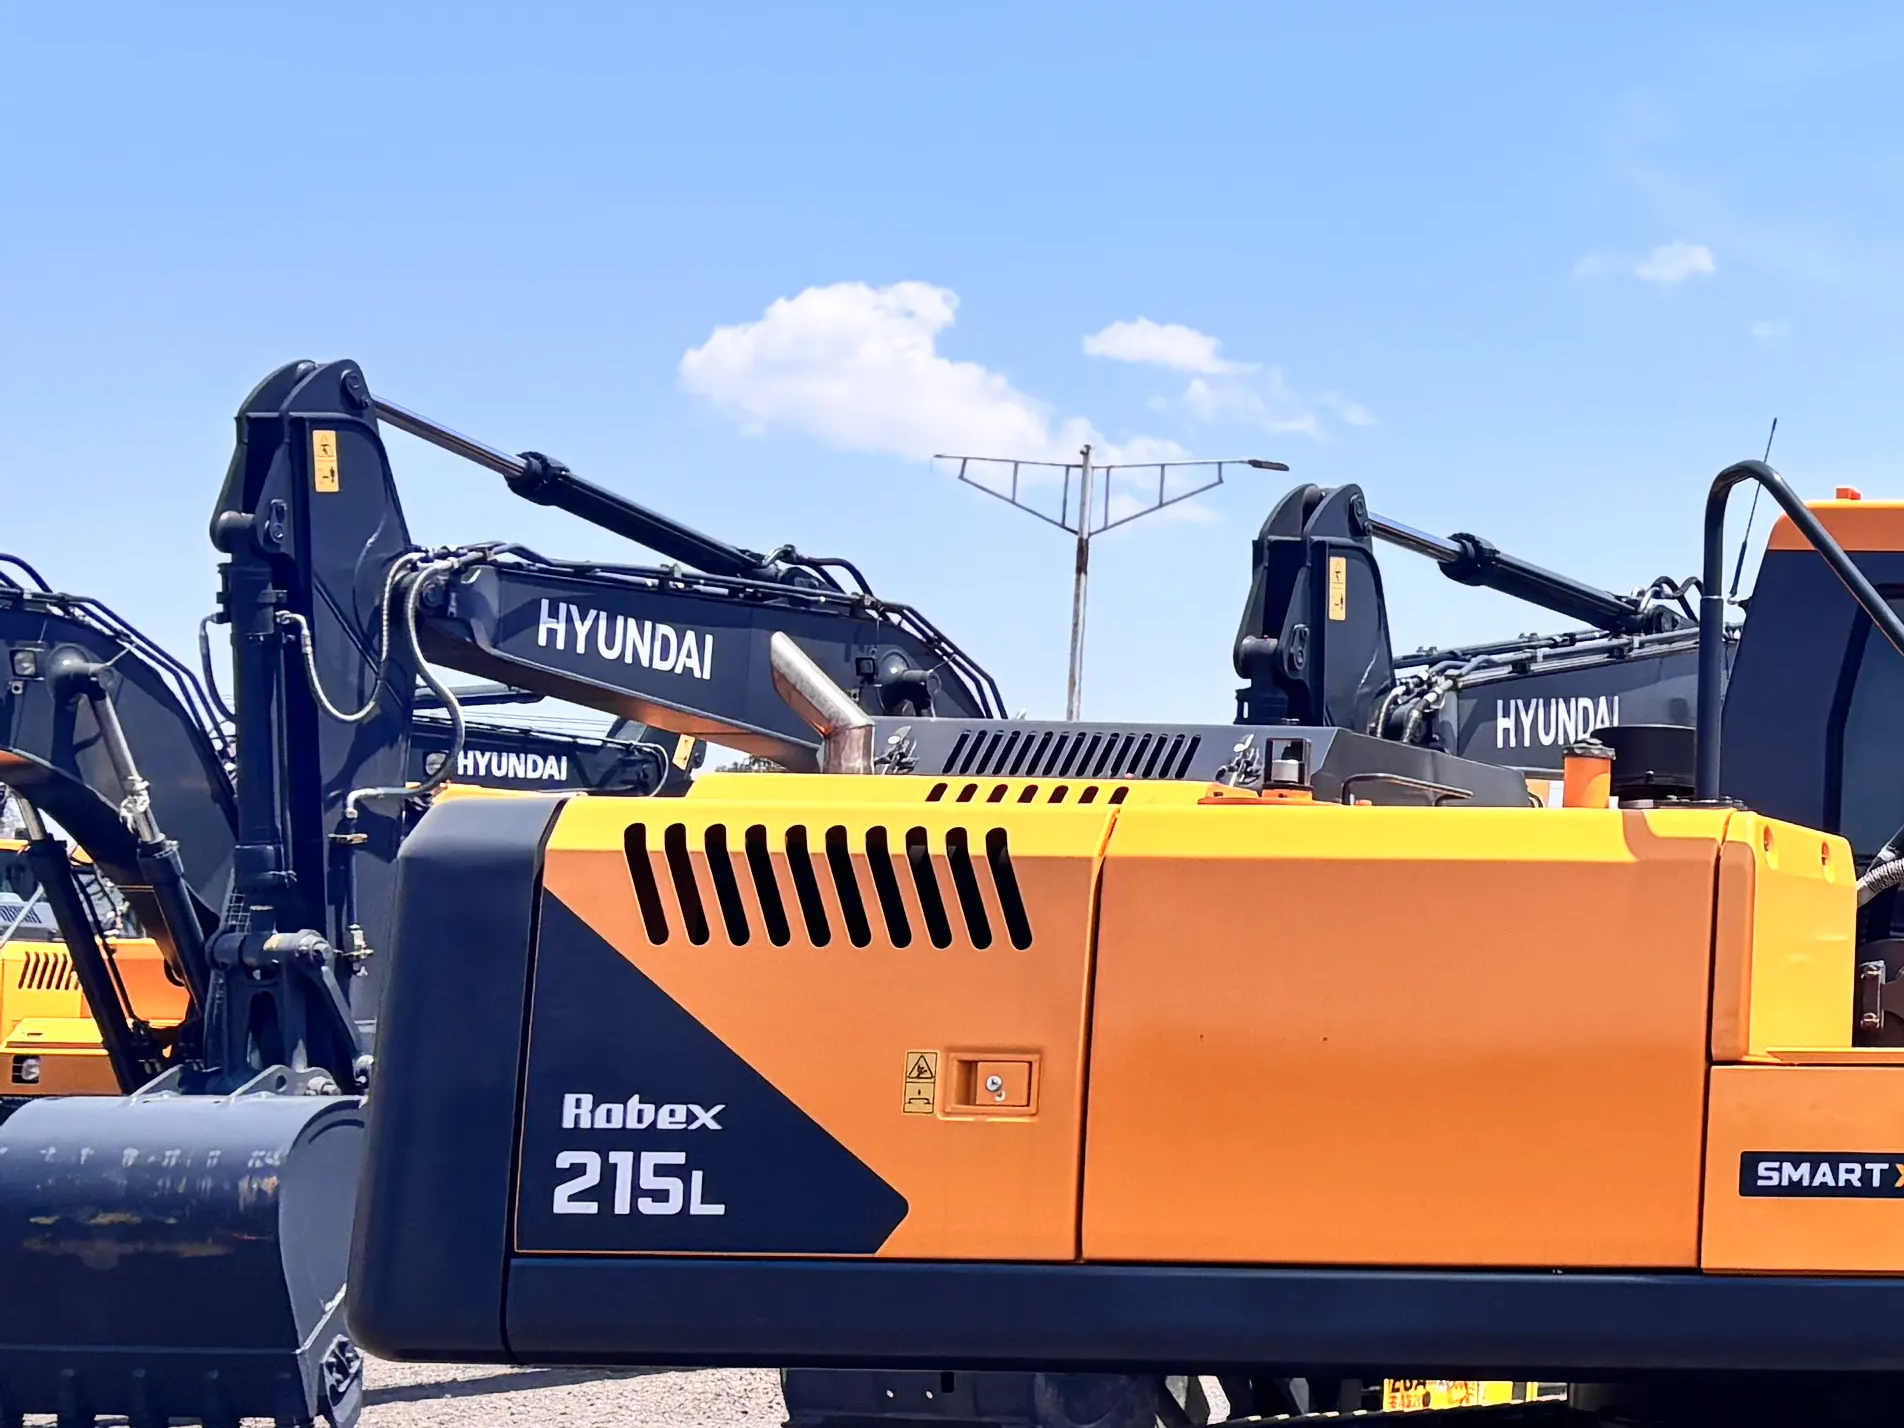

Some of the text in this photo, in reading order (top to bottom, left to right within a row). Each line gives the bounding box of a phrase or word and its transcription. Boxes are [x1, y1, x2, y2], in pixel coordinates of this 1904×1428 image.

[537, 598, 714, 680] HYUNDAI
[1496, 695, 1620, 749] HYUNDAI
[457, 750, 568, 781] HYUNDAI
[562, 1093, 726, 1130] Robex
[553, 1150, 726, 1216] 215L
[1756, 1161, 1890, 1188] SMART
